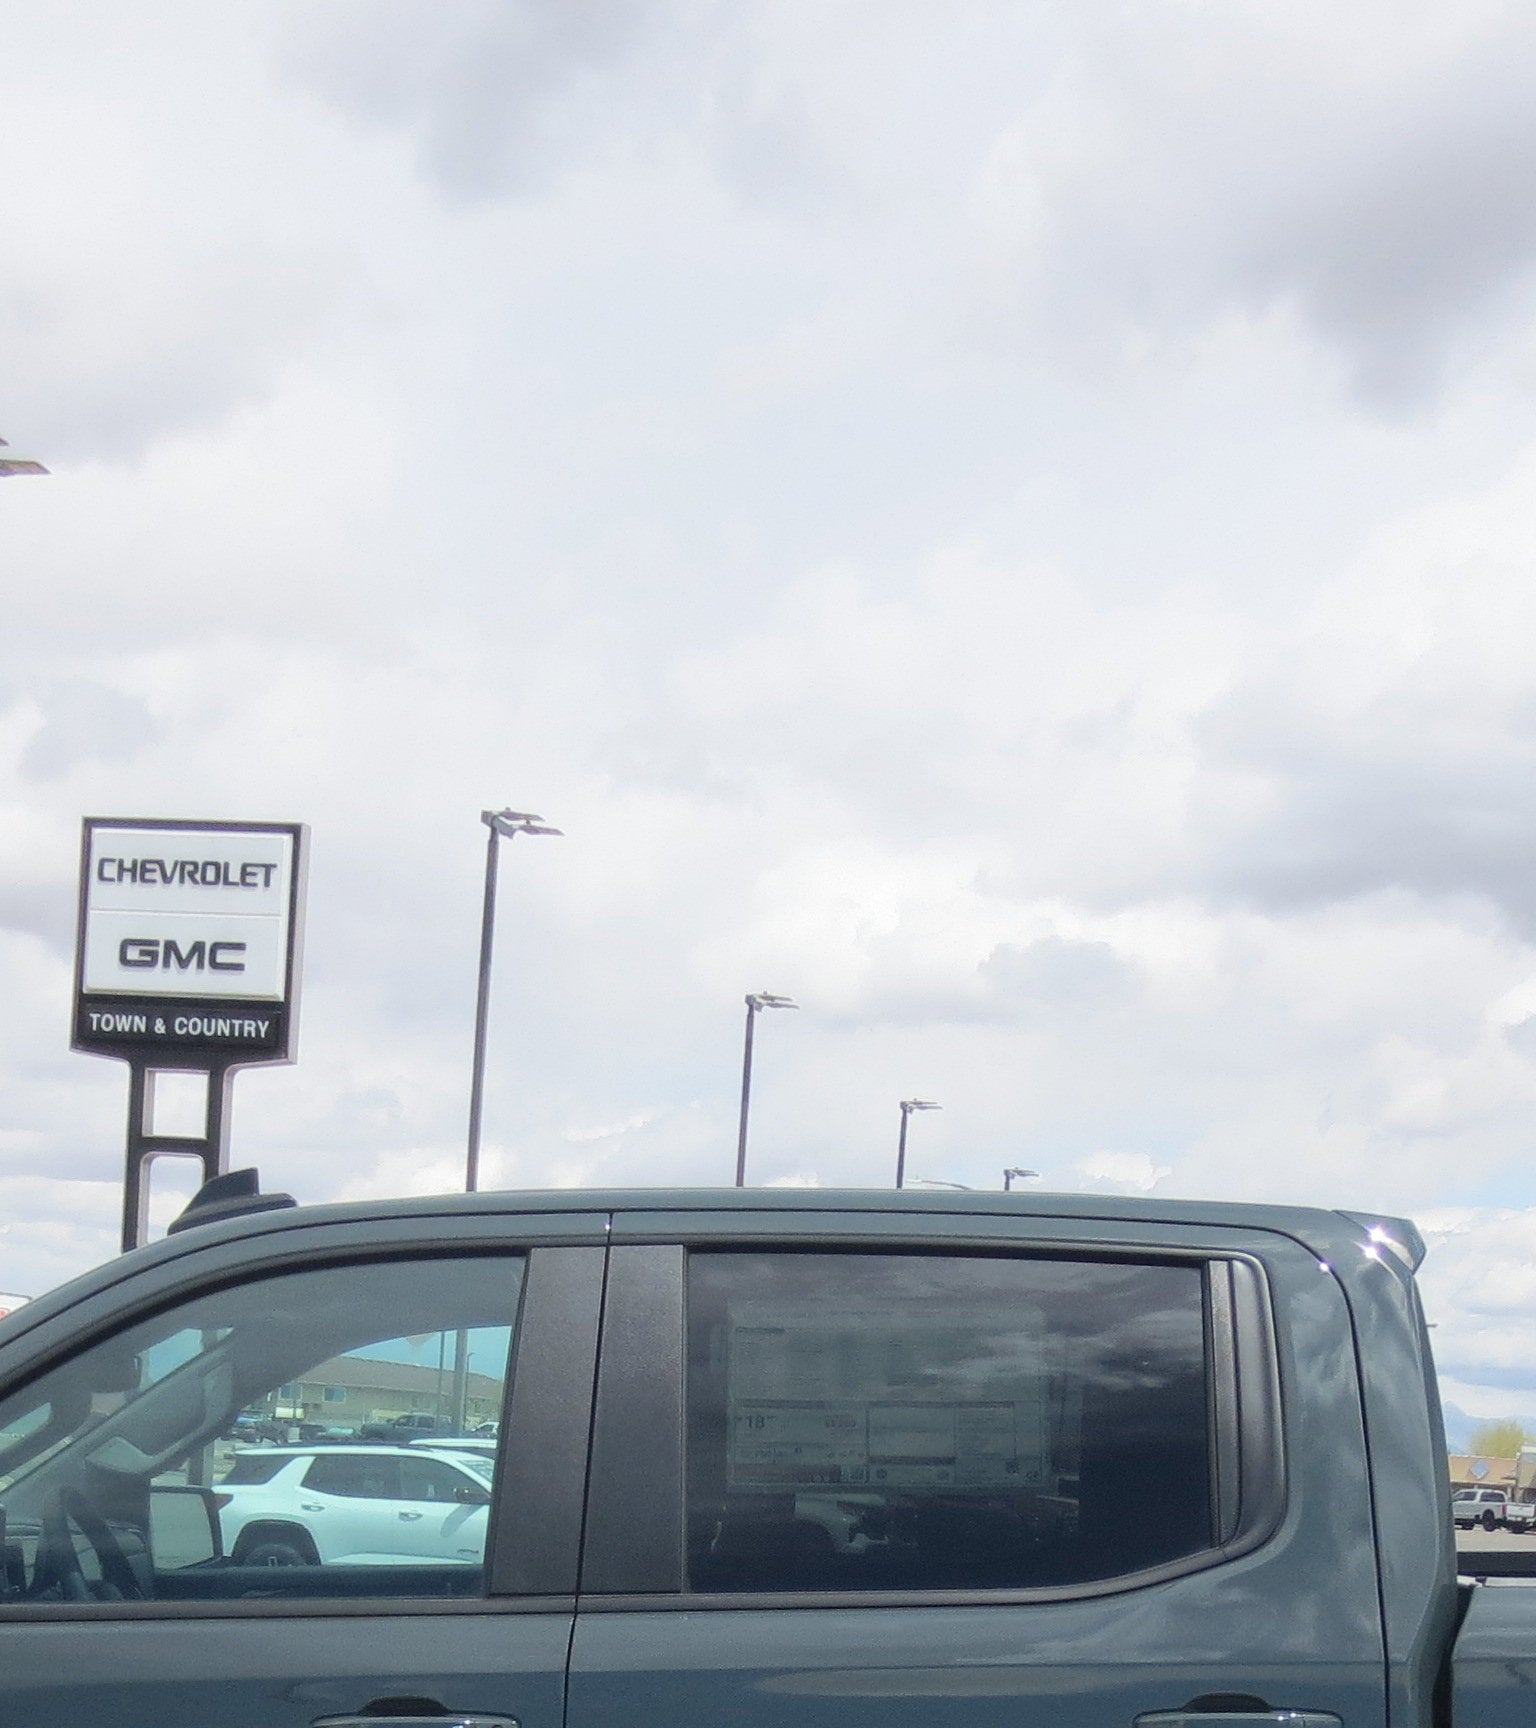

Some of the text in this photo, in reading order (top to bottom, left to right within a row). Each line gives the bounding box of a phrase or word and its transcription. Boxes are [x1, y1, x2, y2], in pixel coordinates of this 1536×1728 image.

[96, 857, 278, 888] CHEVROLET
[118, 937, 247, 973] GMC
[89, 1012, 270, 1039] TOWN & COUNTRY
